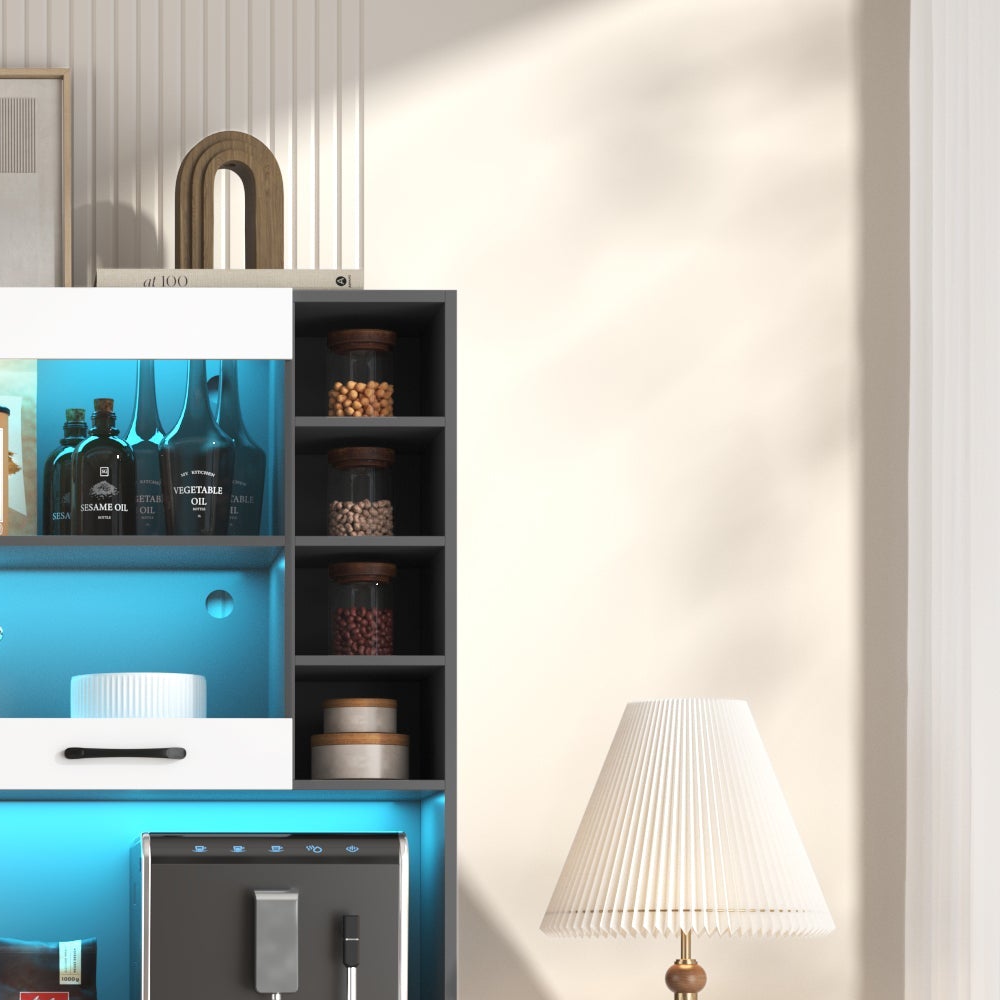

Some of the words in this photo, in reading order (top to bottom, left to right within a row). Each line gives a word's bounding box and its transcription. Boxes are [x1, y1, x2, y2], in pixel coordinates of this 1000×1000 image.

[143, 276, 156, 287] at
[162, 275, 188, 287] 100
[191, 470, 216, 478] KITCHEN
[173, 486, 223, 495] VEGETABLE
[80, 503, 113, 512] SESAME
[114, 503, 129, 512] OIL
[52, 512, 71, 520] SESA
